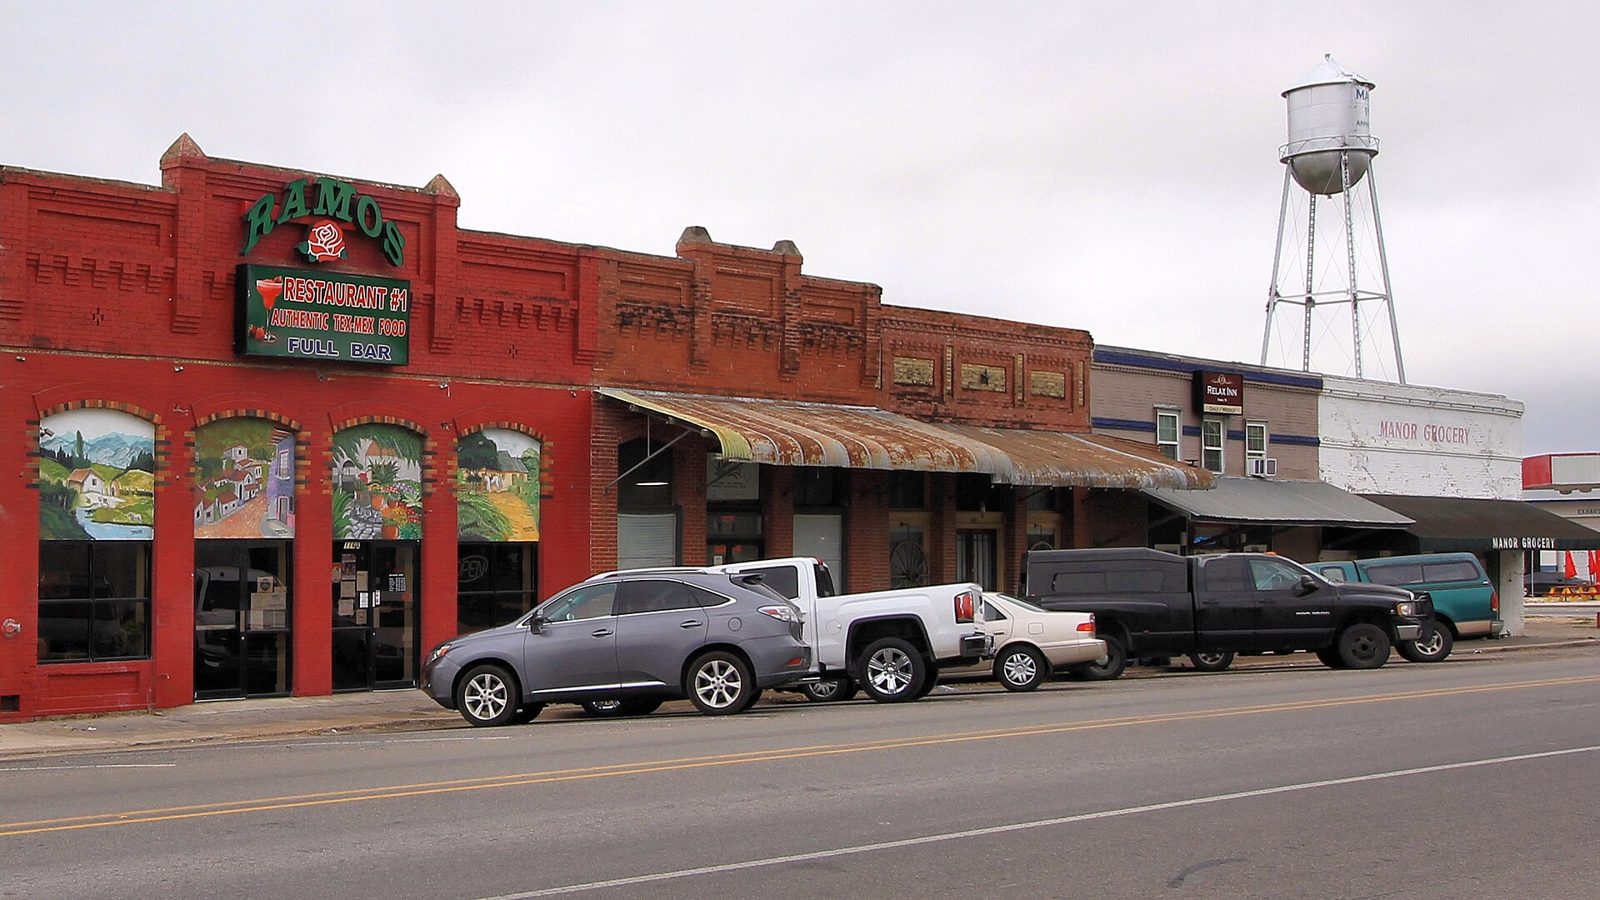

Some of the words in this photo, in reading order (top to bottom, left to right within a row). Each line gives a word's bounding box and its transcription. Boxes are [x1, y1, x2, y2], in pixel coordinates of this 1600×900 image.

[242, 177, 405, 266] RAMOS
[284, 277, 387, 310] RESTAURANT
[390, 288, 408, 312] #1
[271, 308, 329, 331] AUTHENTIC
[333, 314, 375, 334] TEX-MEX
[378, 318, 406, 337] FOOD
[288, 337, 339, 356] FULL
[351, 343, 392, 360] BAR
[1380, 421, 1417, 440] MANOR
[1424, 424, 1470, 444] GROCERY
[1492, 537, 1518, 549] MANOR
[1522, 537, 1556, 549] GROCERY
[458, 560, 486, 578] PEN
